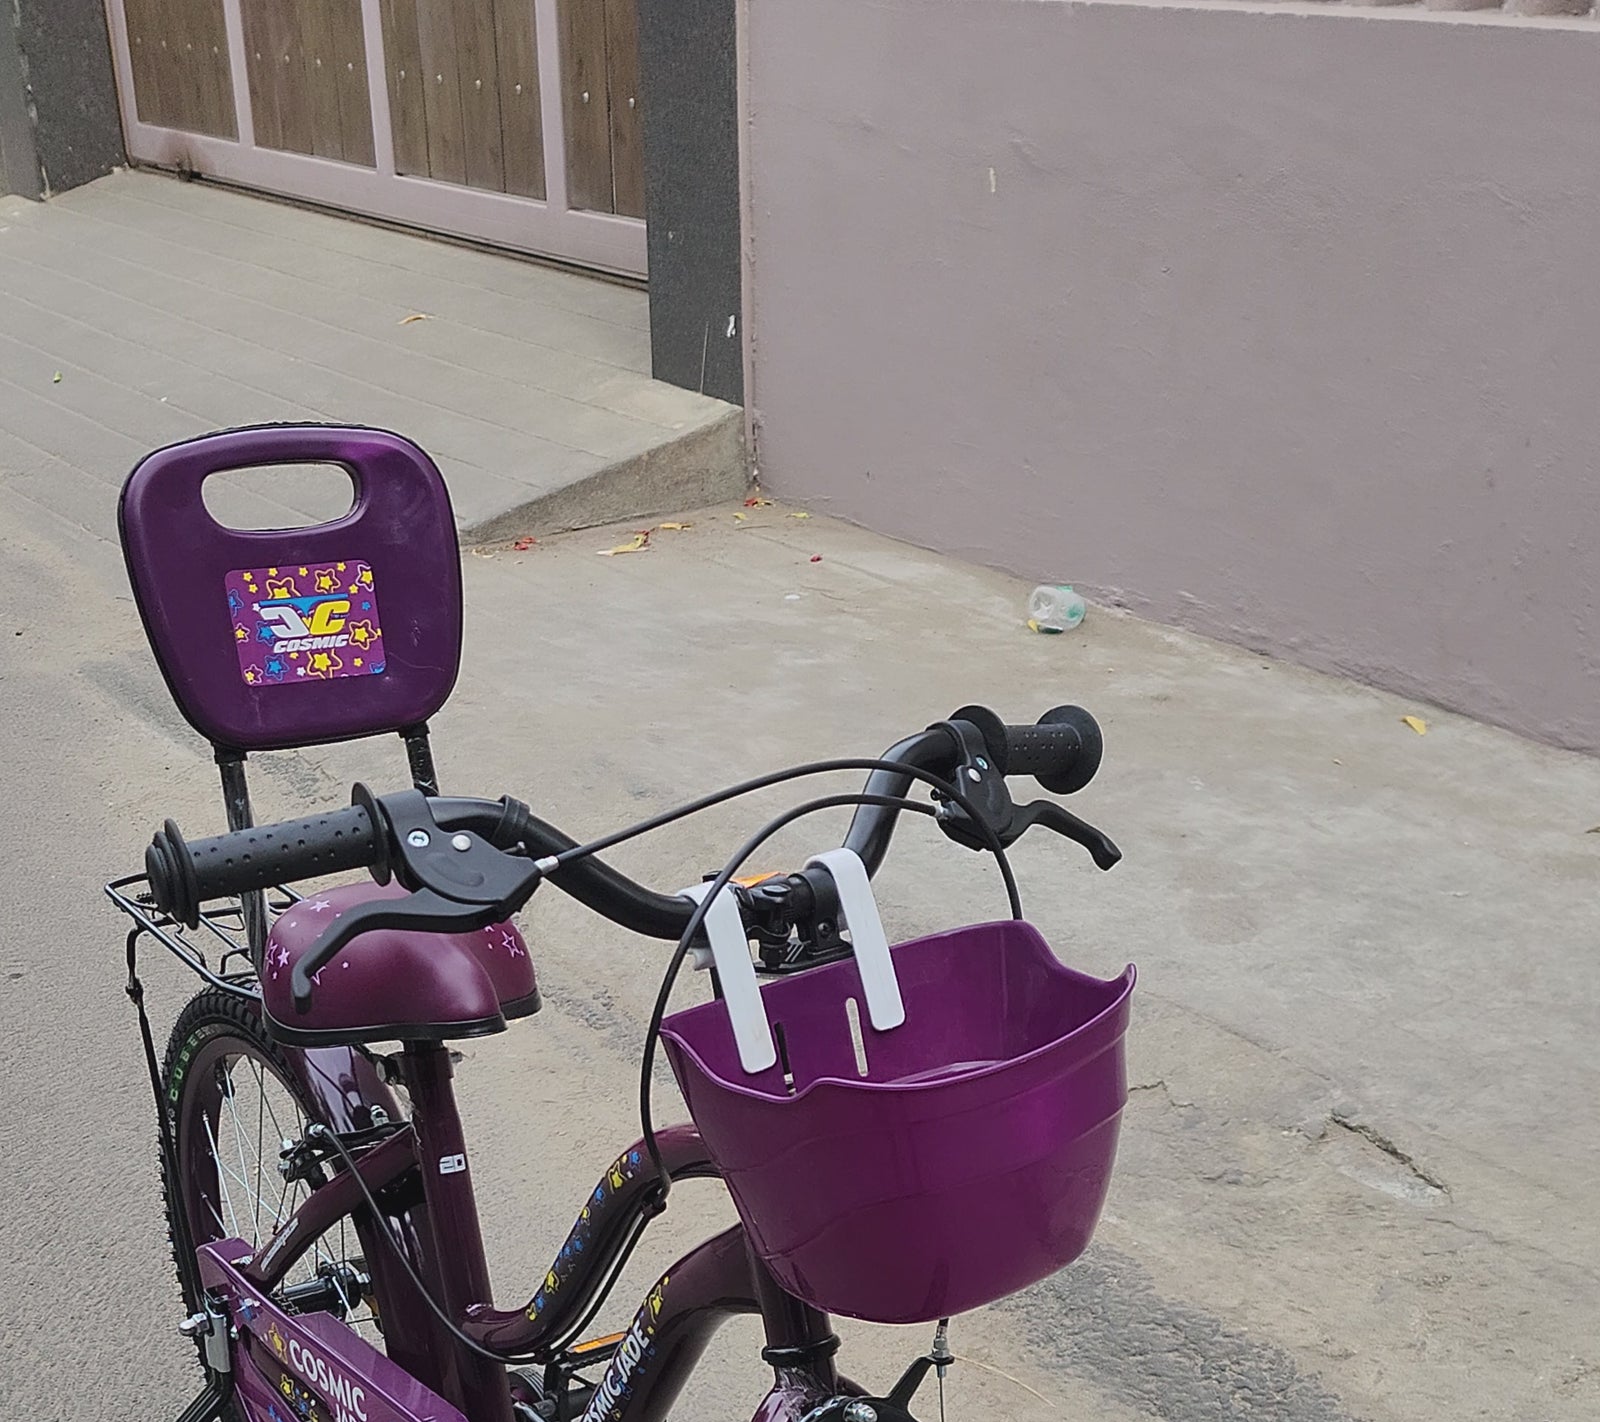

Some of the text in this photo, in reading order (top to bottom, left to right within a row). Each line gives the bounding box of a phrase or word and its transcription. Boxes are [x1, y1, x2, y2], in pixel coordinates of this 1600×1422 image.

[273, 634, 349, 653] COSMIC
[288, 1339, 368, 1422] COSMIC
[617, 1320, 650, 1386] JADE
